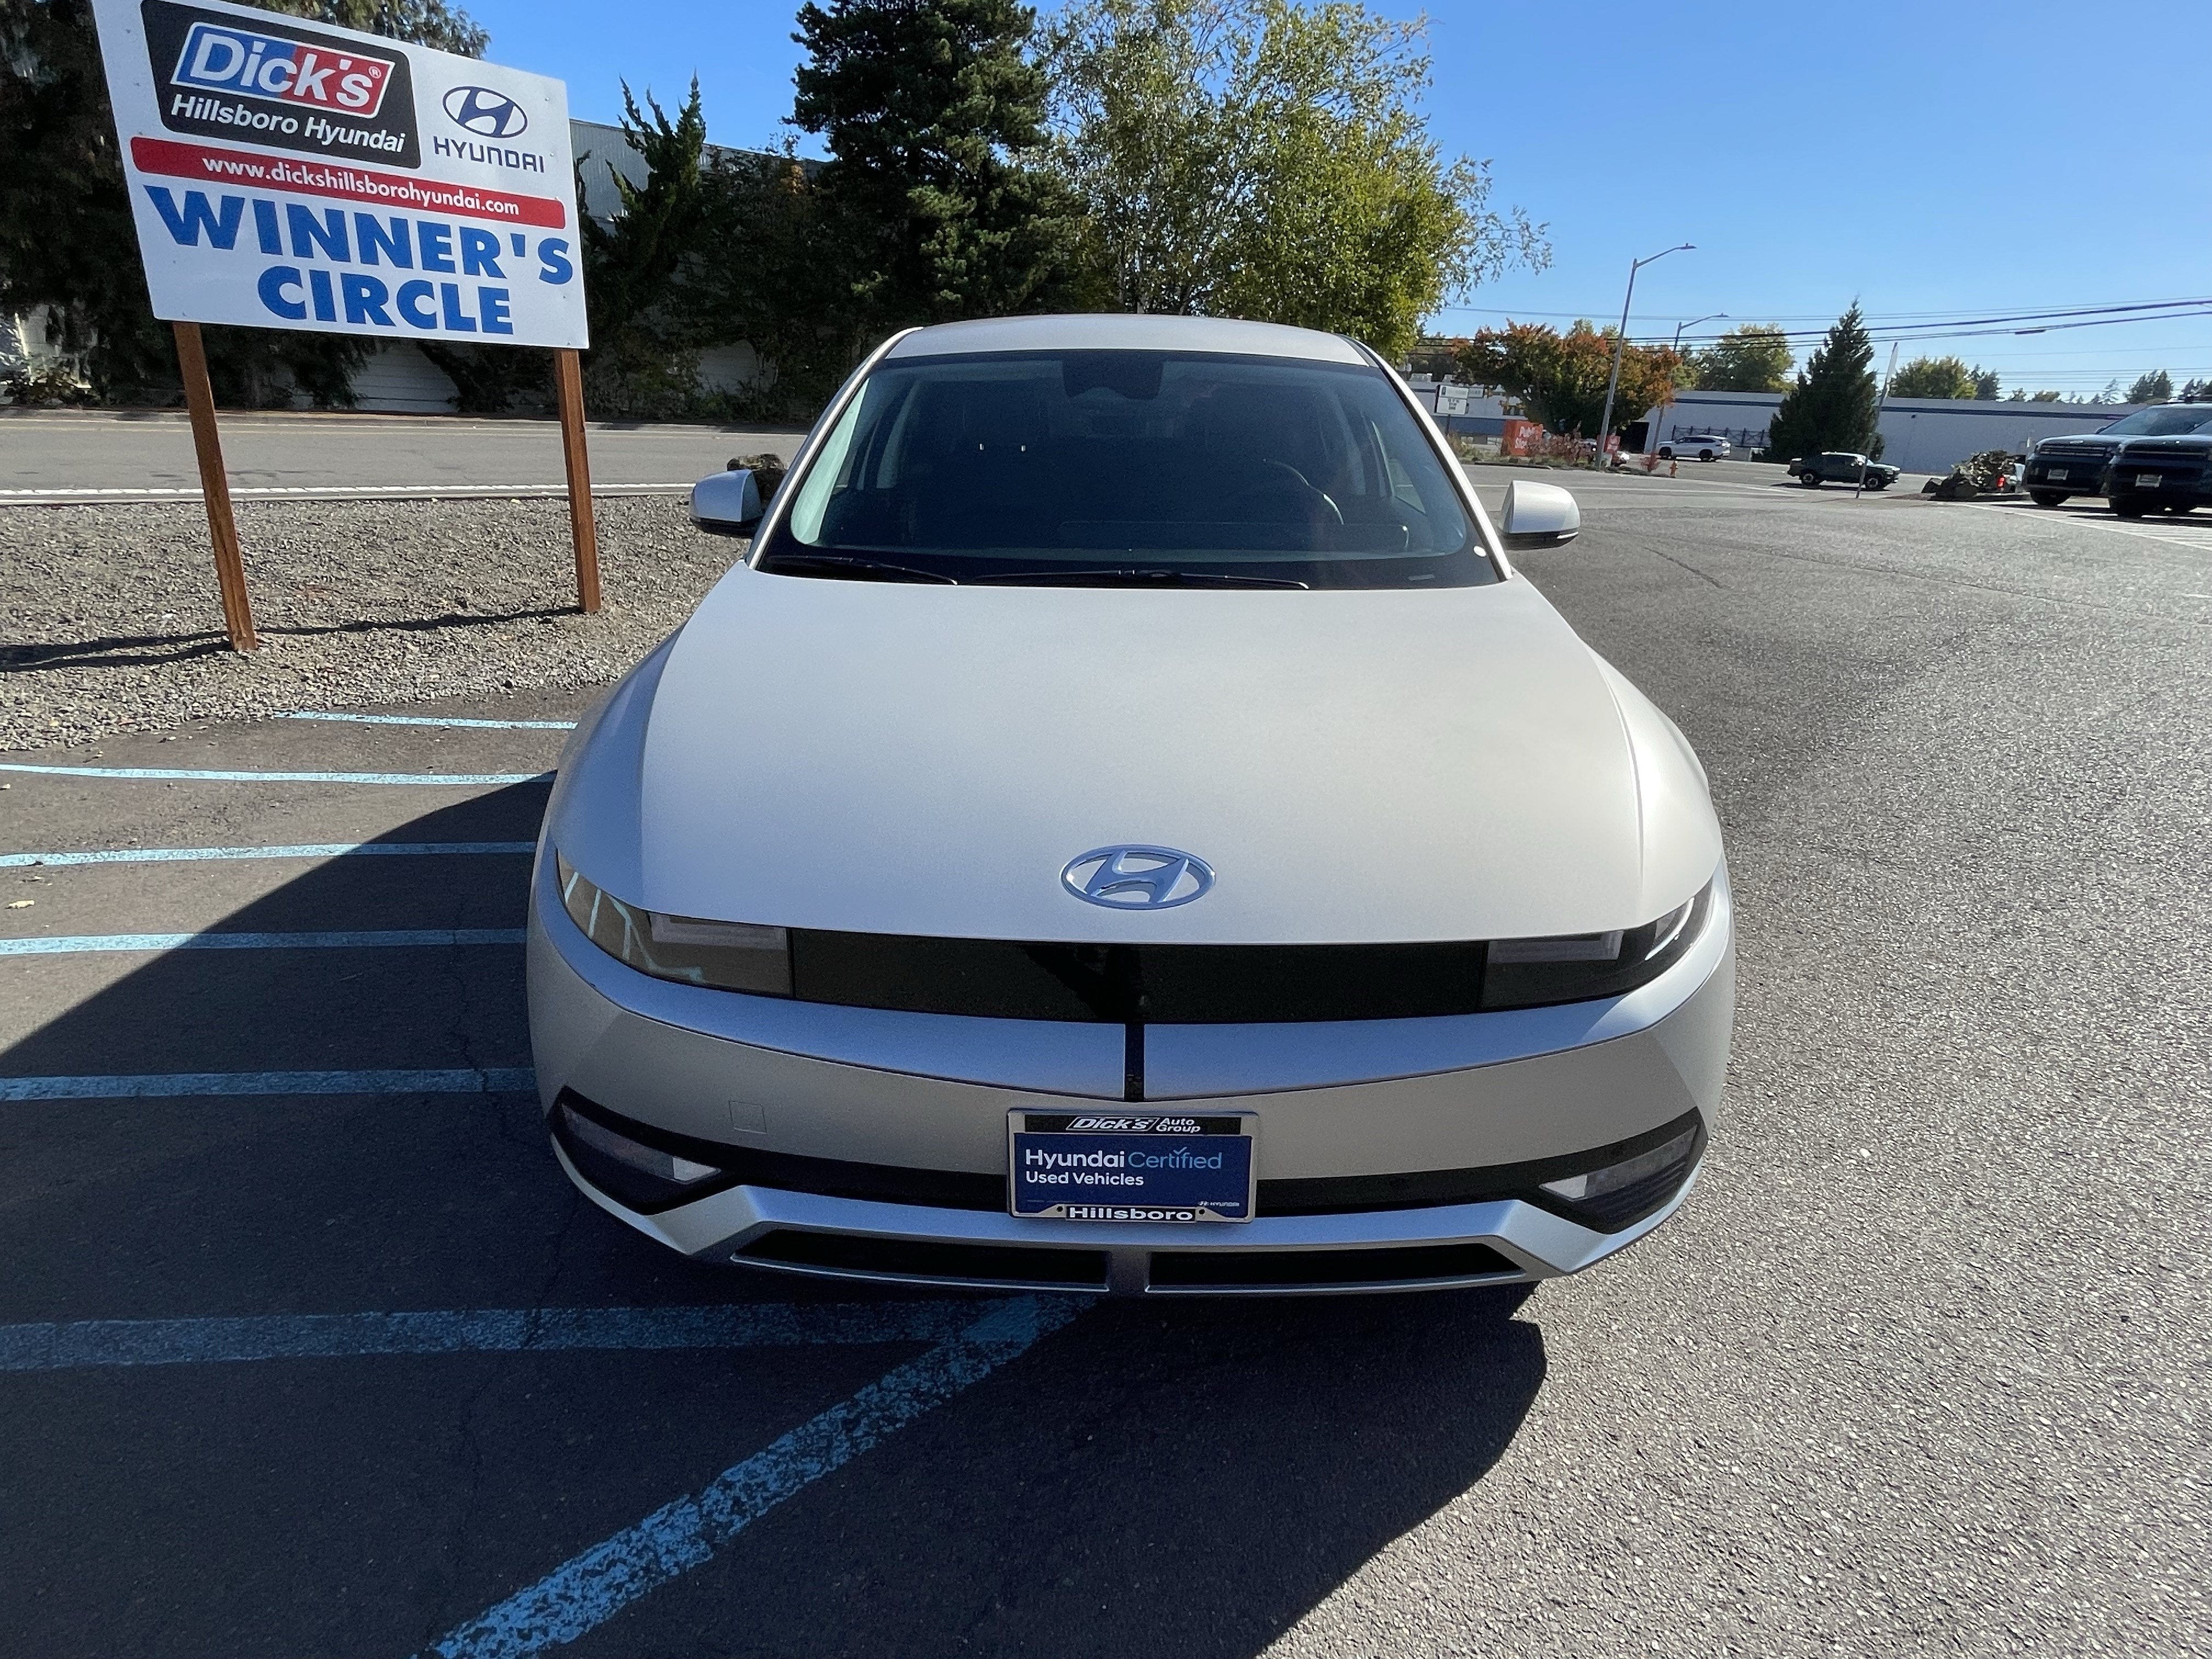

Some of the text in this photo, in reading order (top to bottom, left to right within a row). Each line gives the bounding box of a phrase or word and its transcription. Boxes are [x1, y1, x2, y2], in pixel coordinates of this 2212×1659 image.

[190, 33, 373, 108] Dick's
[171, 94, 406, 153] Hillsboro Hyundai
[433, 136, 545, 173] HYUNDAI
[202, 156, 520, 215] www.dickshillsborohyundai.com
[143, 184, 573, 285] WINNER'S
[257, 266, 514, 335] CIRCLE
[1073, 1118, 1149, 1129] Dick's
[1155, 1125, 1201, 1133] Group
[1025, 1147, 1222, 1169] Hyundai Certified
[1026, 1171, 1144, 1186] Used Vehicles
[1069, 1207, 1193, 1220] Hillsboro
